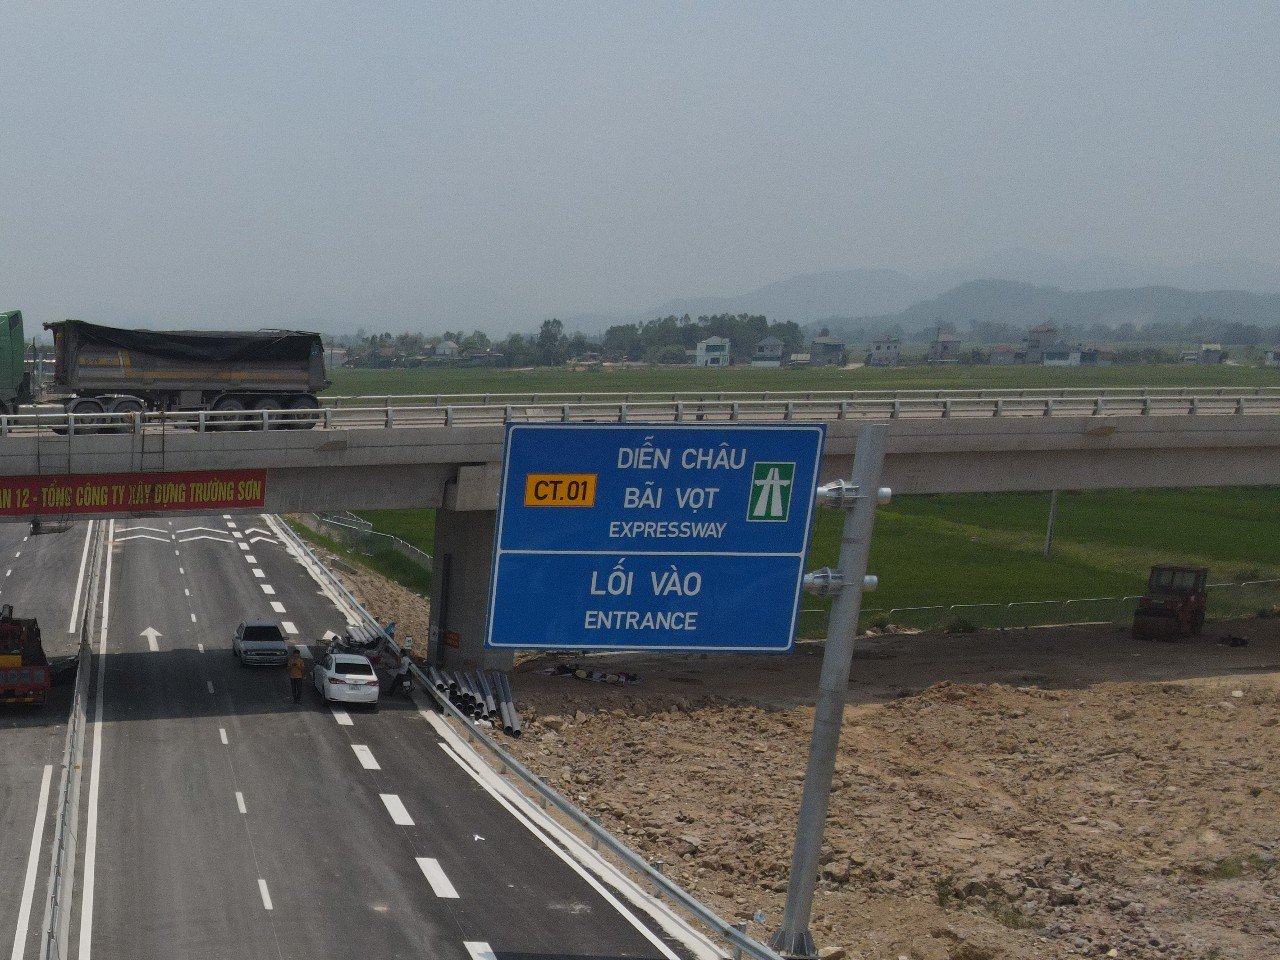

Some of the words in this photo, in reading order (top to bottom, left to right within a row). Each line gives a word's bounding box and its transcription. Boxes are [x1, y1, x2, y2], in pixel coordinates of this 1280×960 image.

[616, 435, 671, 470] DIỄN
[680, 441, 747, 470] CHÂU
[15, 488, 30, 508] 12
[75, 482, 109, 507] CÔNG
[111, 485, 126, 506] TY
[533, 479, 589, 502] CT.01
[623, 481, 663, 509] BÃI
[675, 487, 720, 514] VỌT
[608, 521, 728, 539] EXPRESSWAY
[589, 557, 634, 596] LỐI
[650, 564, 703, 597] VÀO
[583, 610, 699, 631] ENTRANCE
